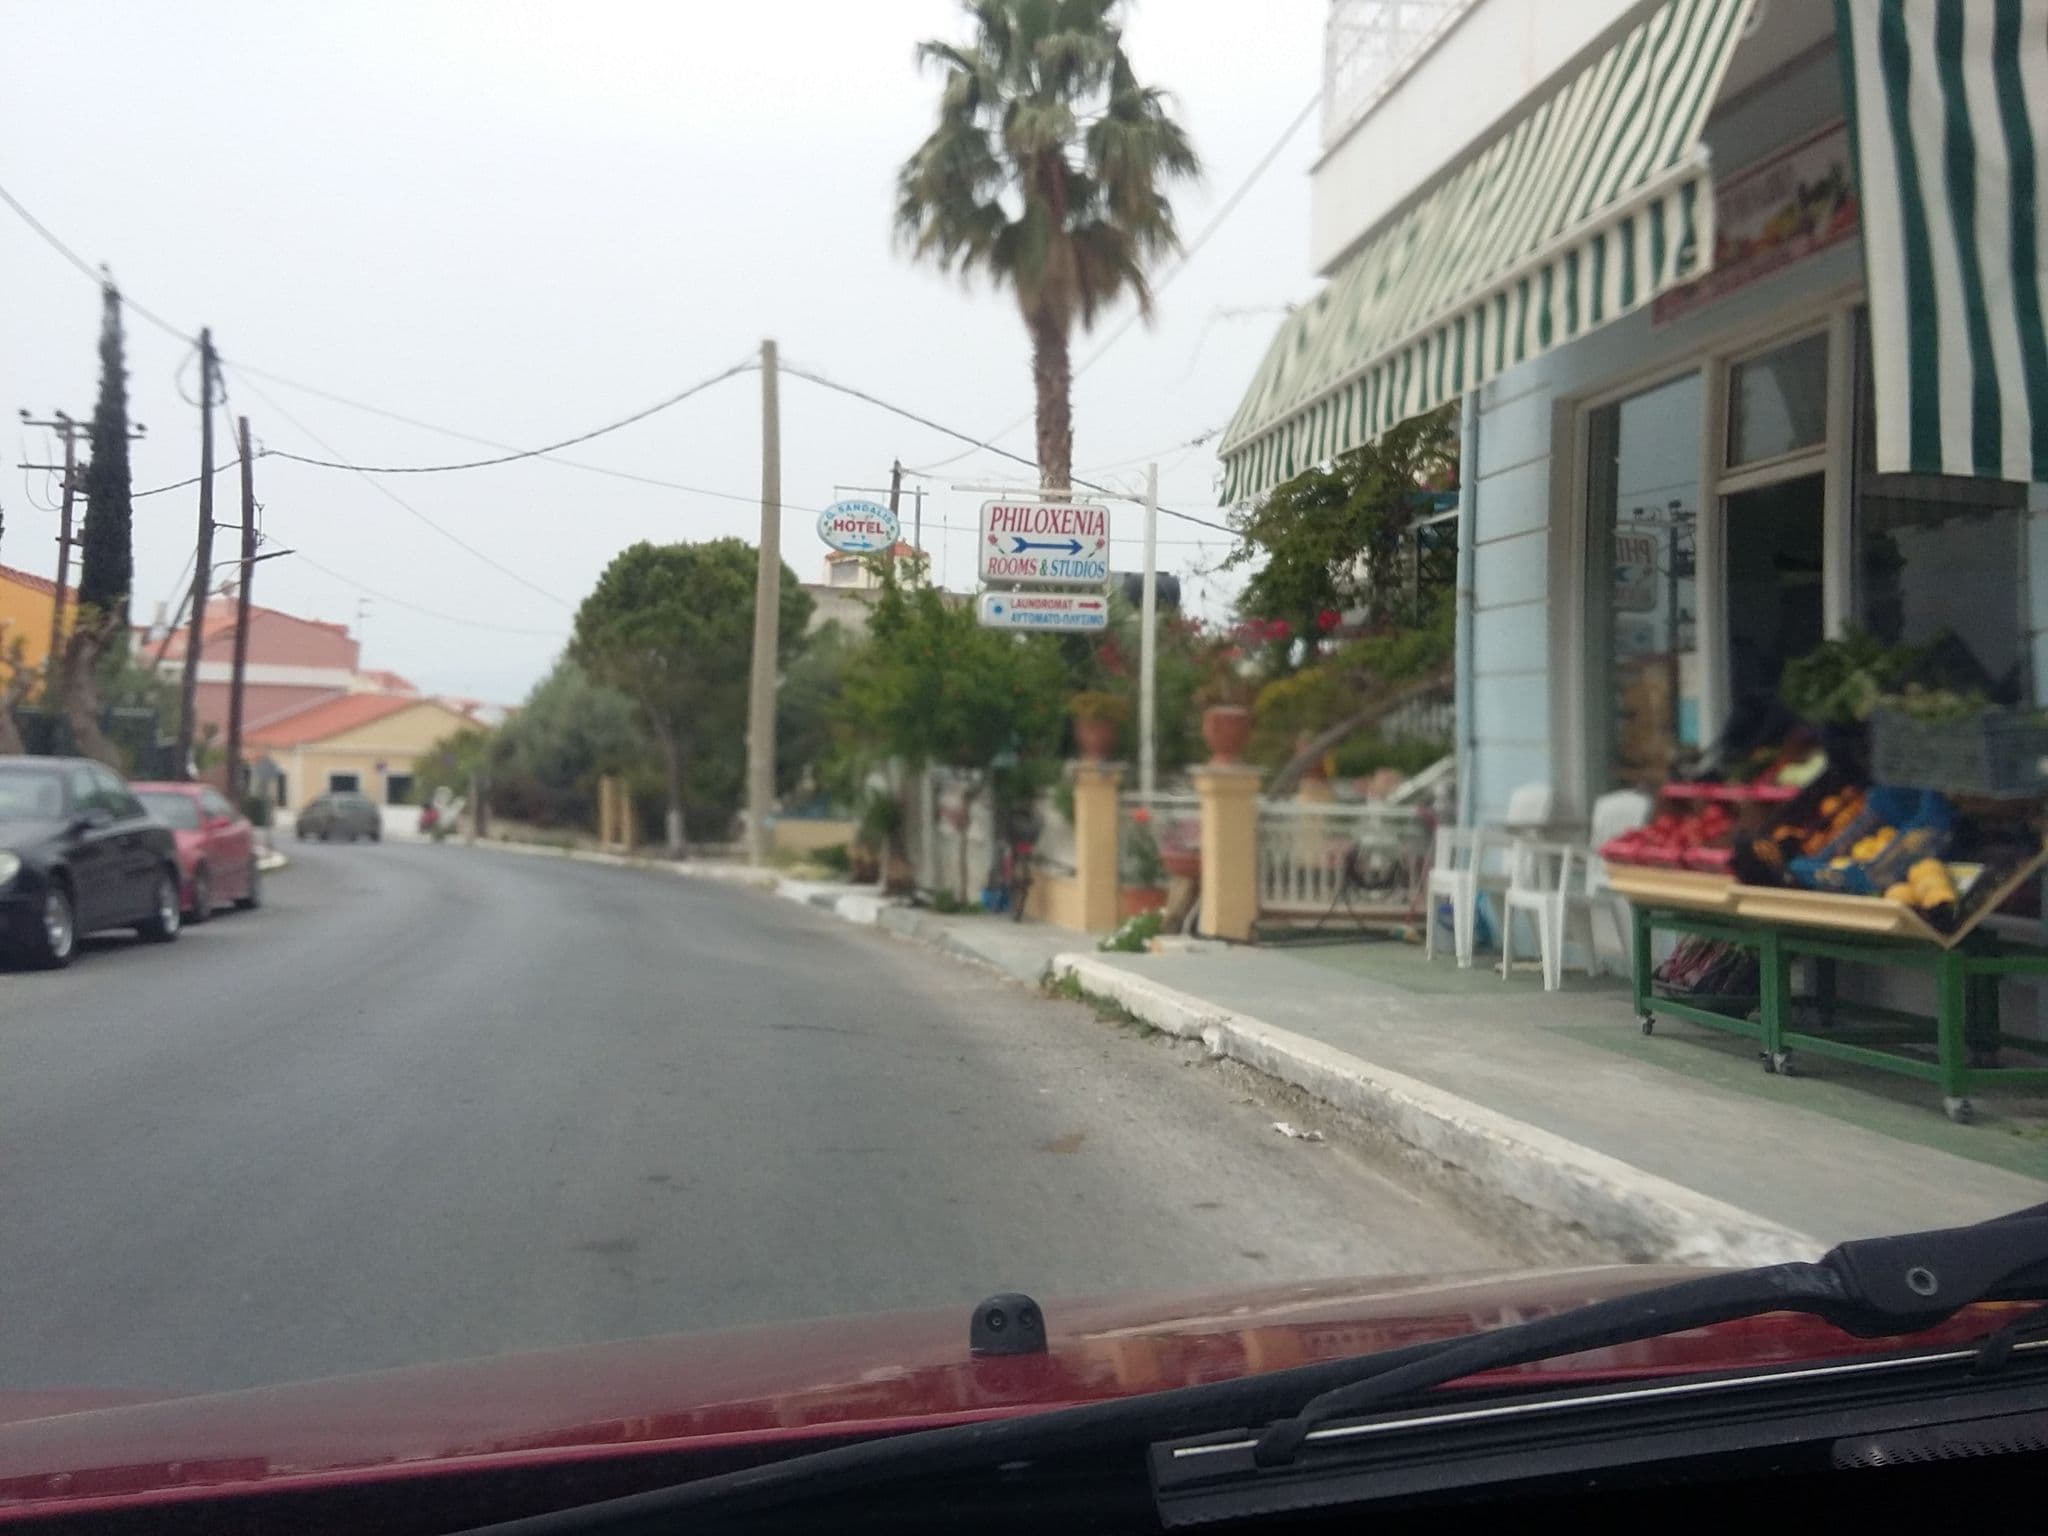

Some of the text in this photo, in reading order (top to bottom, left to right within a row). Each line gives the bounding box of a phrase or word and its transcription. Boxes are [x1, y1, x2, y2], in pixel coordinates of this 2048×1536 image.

[833, 519, 885, 535] HOTEL
[989, 507, 1105, 536] PHILOXENIA
[988, 557, 1105, 578] ROOMS & STUDIOS
[1011, 599, 1073, 611] LAUNDROMAT
